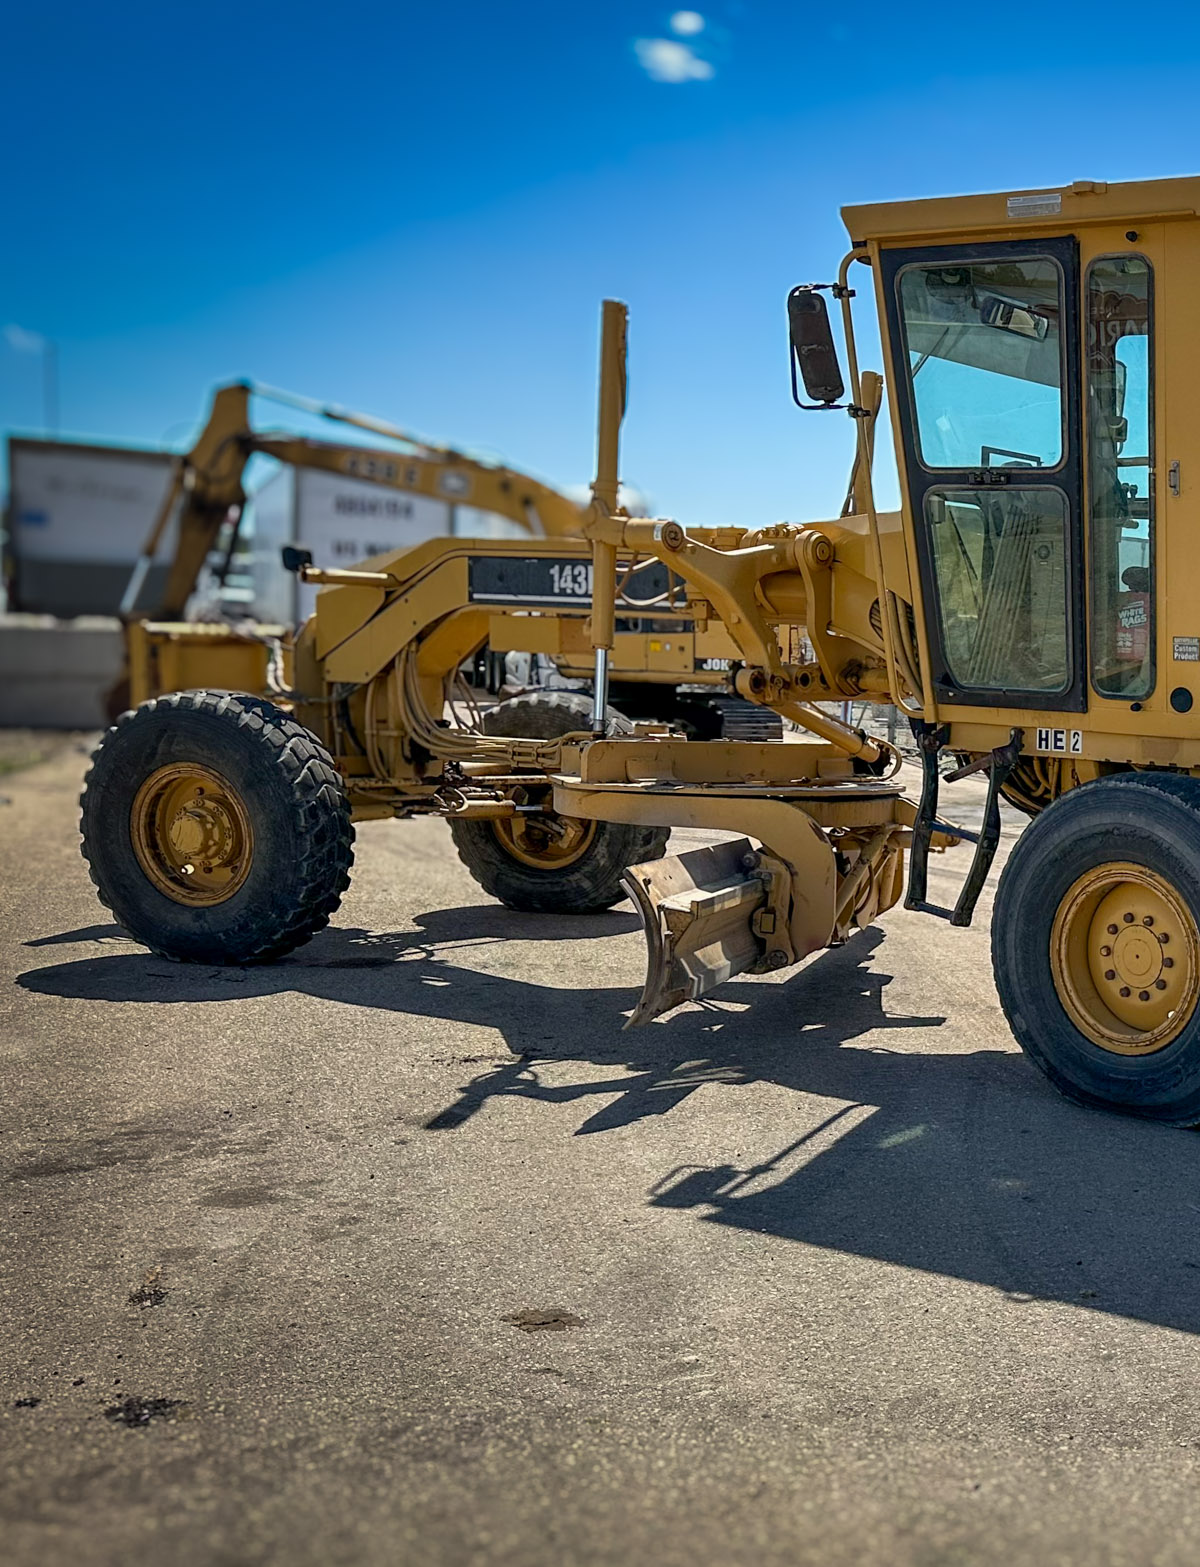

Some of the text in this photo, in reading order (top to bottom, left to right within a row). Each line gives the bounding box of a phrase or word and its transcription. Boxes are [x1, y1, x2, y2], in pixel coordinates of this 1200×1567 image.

[1118, 607, 1144, 619] WHITE
[1121, 613, 1147, 629] RAGS
[1174, 644, 1198, 652] Custom
[1174, 652, 1198, 660] Product
[1038, 729, 1080, 752] HE 2
